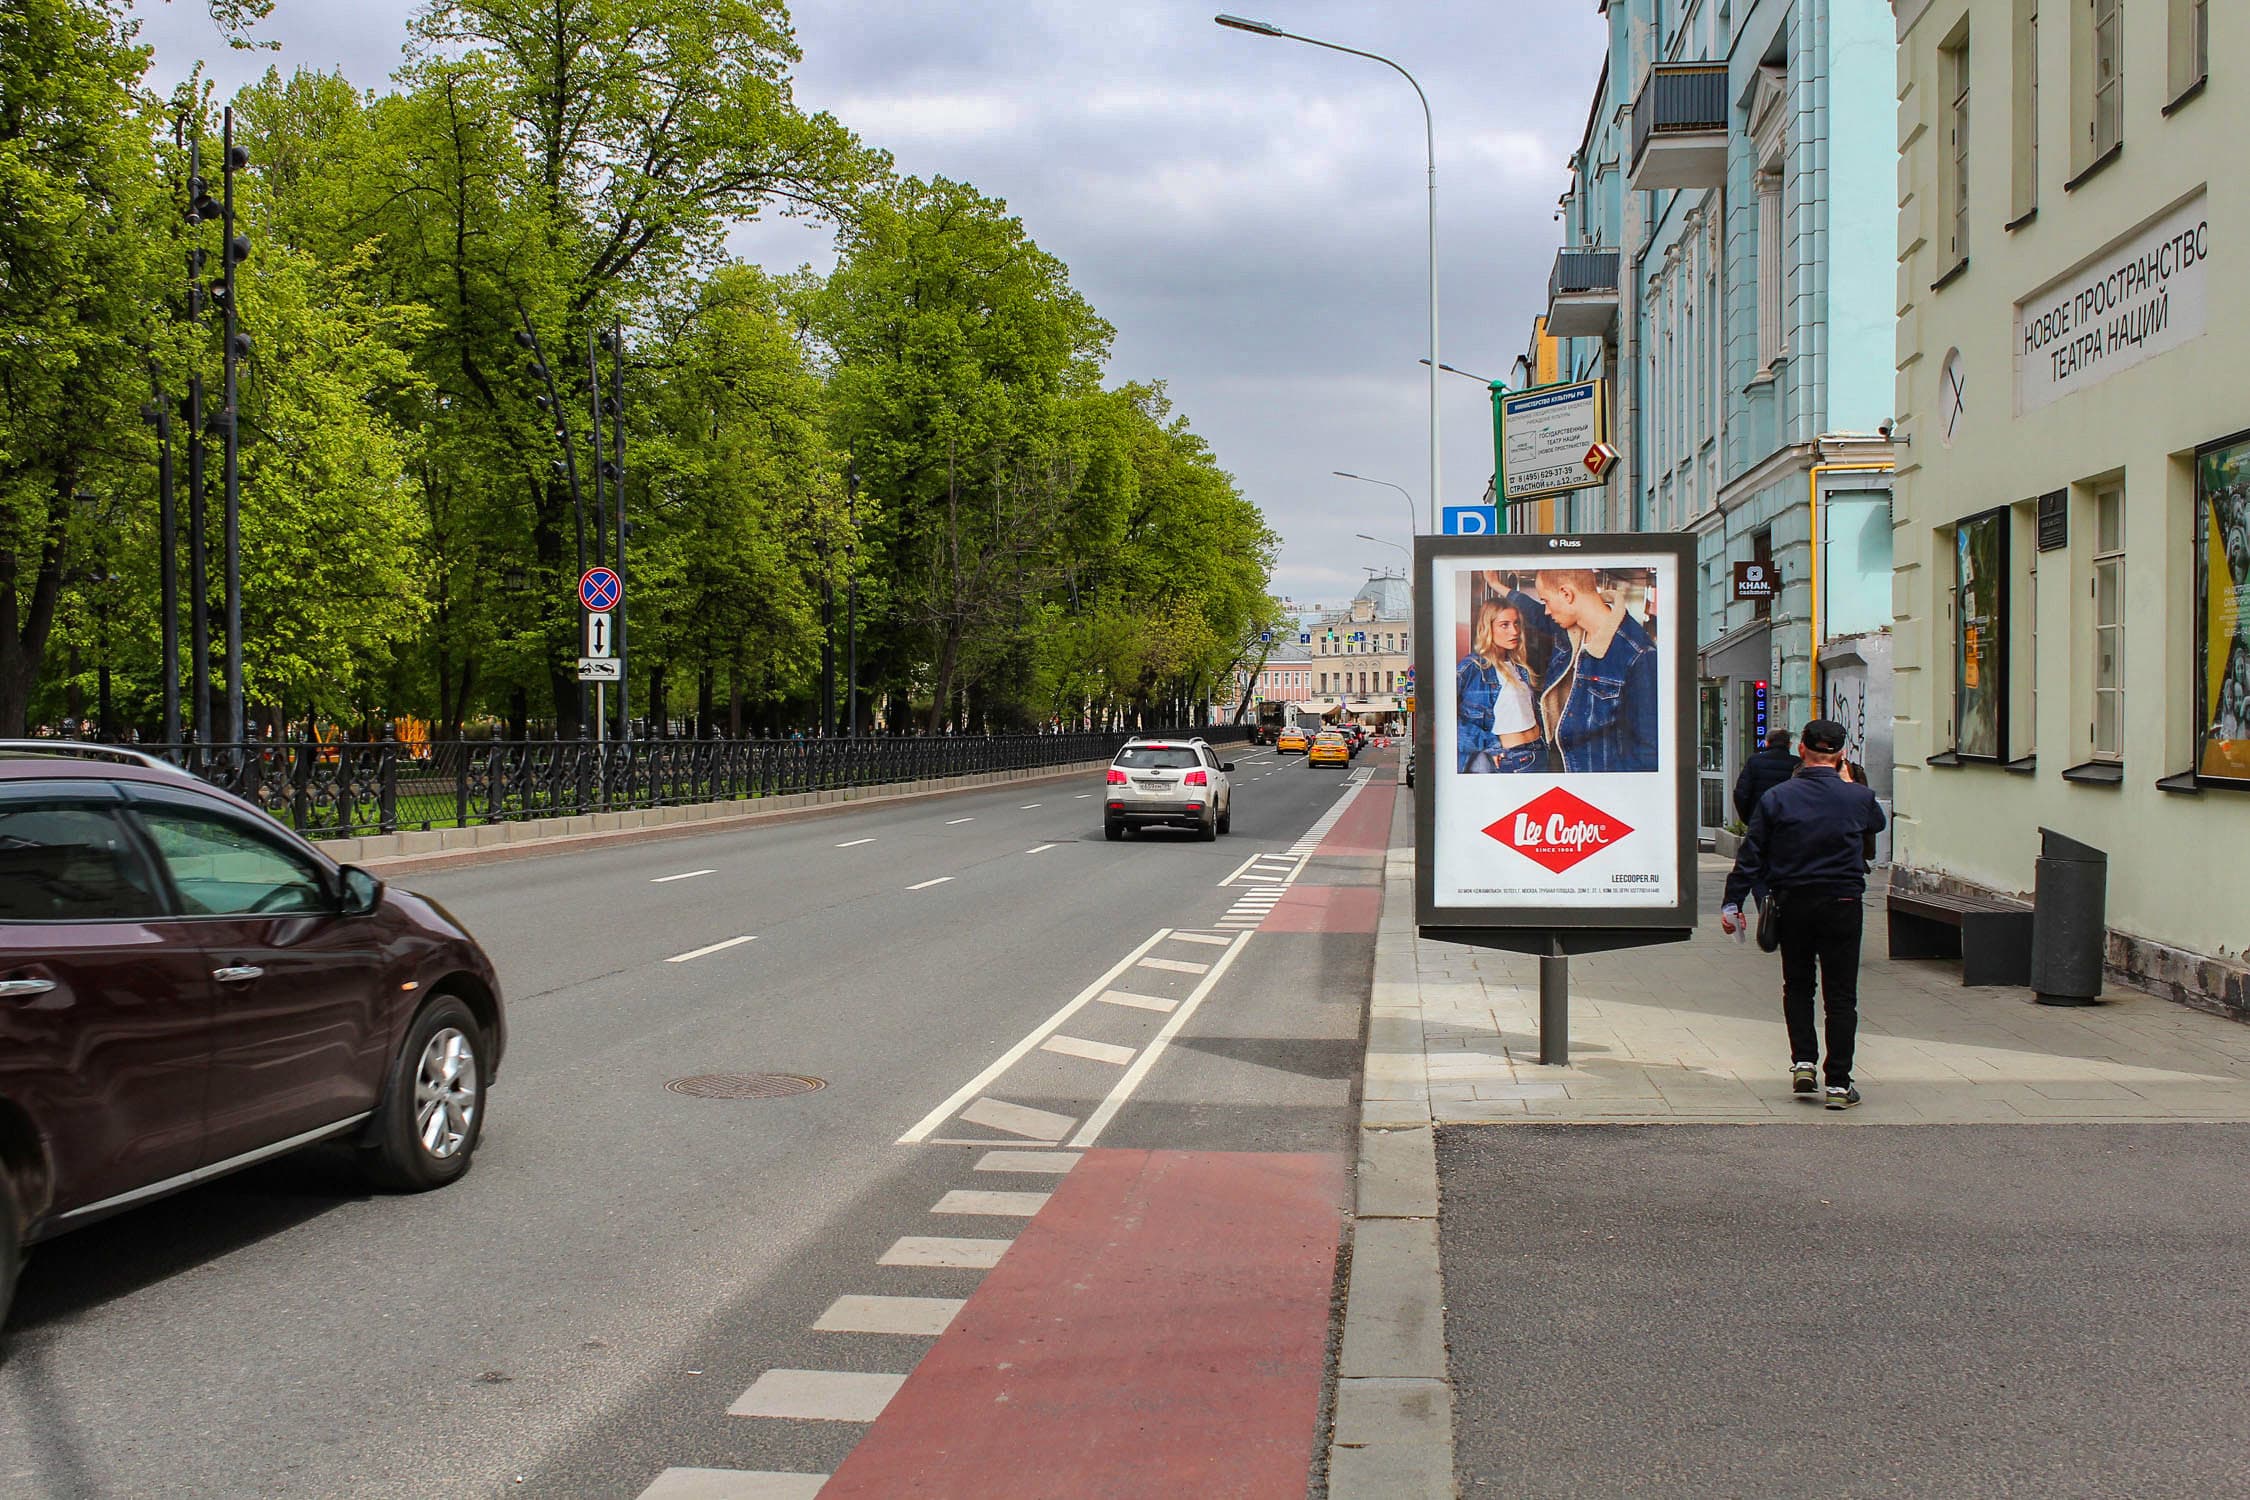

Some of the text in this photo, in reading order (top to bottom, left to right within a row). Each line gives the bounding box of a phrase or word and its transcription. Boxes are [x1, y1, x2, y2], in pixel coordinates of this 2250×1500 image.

[2024, 221, 2207, 355] НОВОЕ ПРОСТРАНСТВО
[2050, 285, 2168, 382] ТЕАТРА НАЦИЙ
[1576, 390, 1585, 398] РФ
[1539, 424, 1588, 439] ГОСУДАРСТВЕННЫЙ
[1523, 472, 1540, 482] (495)
[1540, 466, 1573, 478] 629-37-39
[1510, 479, 1545, 493] СТРАСТНОЙ
[1559, 539, 1582, 548] Russ
[1756, 689, 1768, 753] СЕРВИ
[1514, 812, 1608, 852] Lee Cooper
[1611, 874, 1660, 883] LEECOOPER.RU
